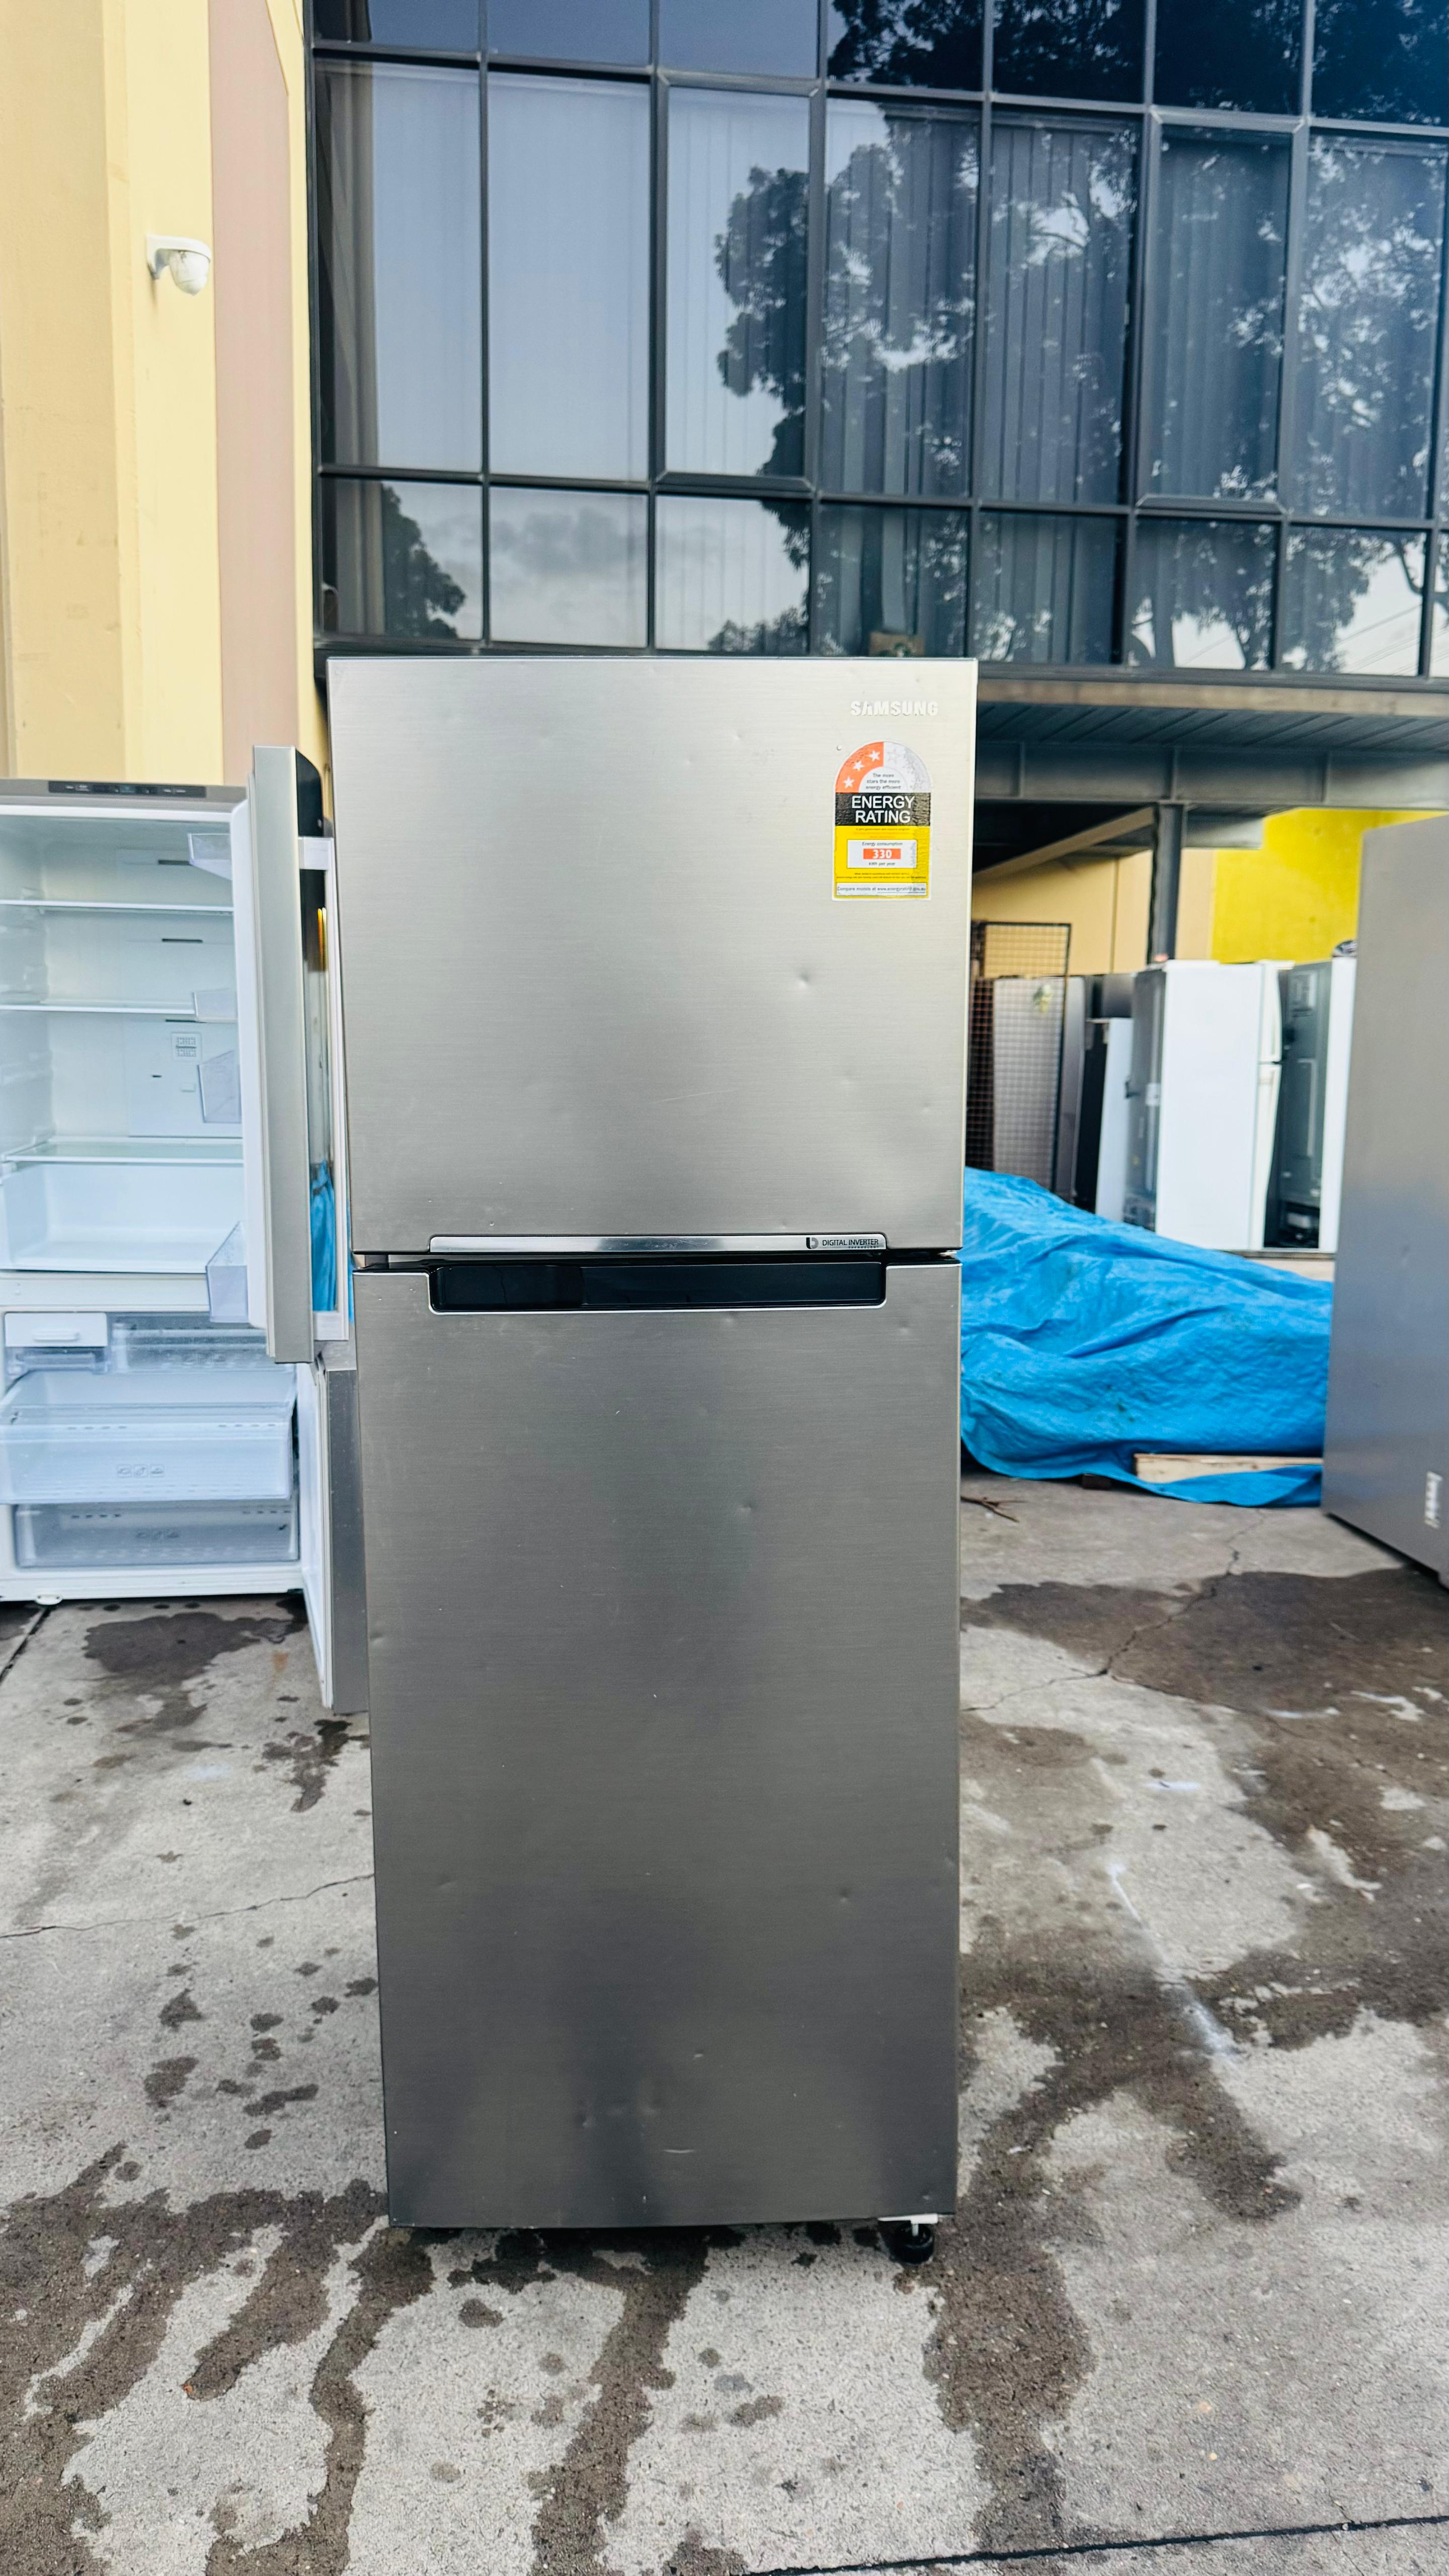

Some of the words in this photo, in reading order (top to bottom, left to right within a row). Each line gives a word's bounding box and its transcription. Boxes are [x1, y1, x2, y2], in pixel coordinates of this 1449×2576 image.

[850, 700, 938, 716] SAMSUNG
[852, 795, 915, 809] ENERGY
[855, 810, 911, 823] RATING
[873, 849, 892, 859] 330
